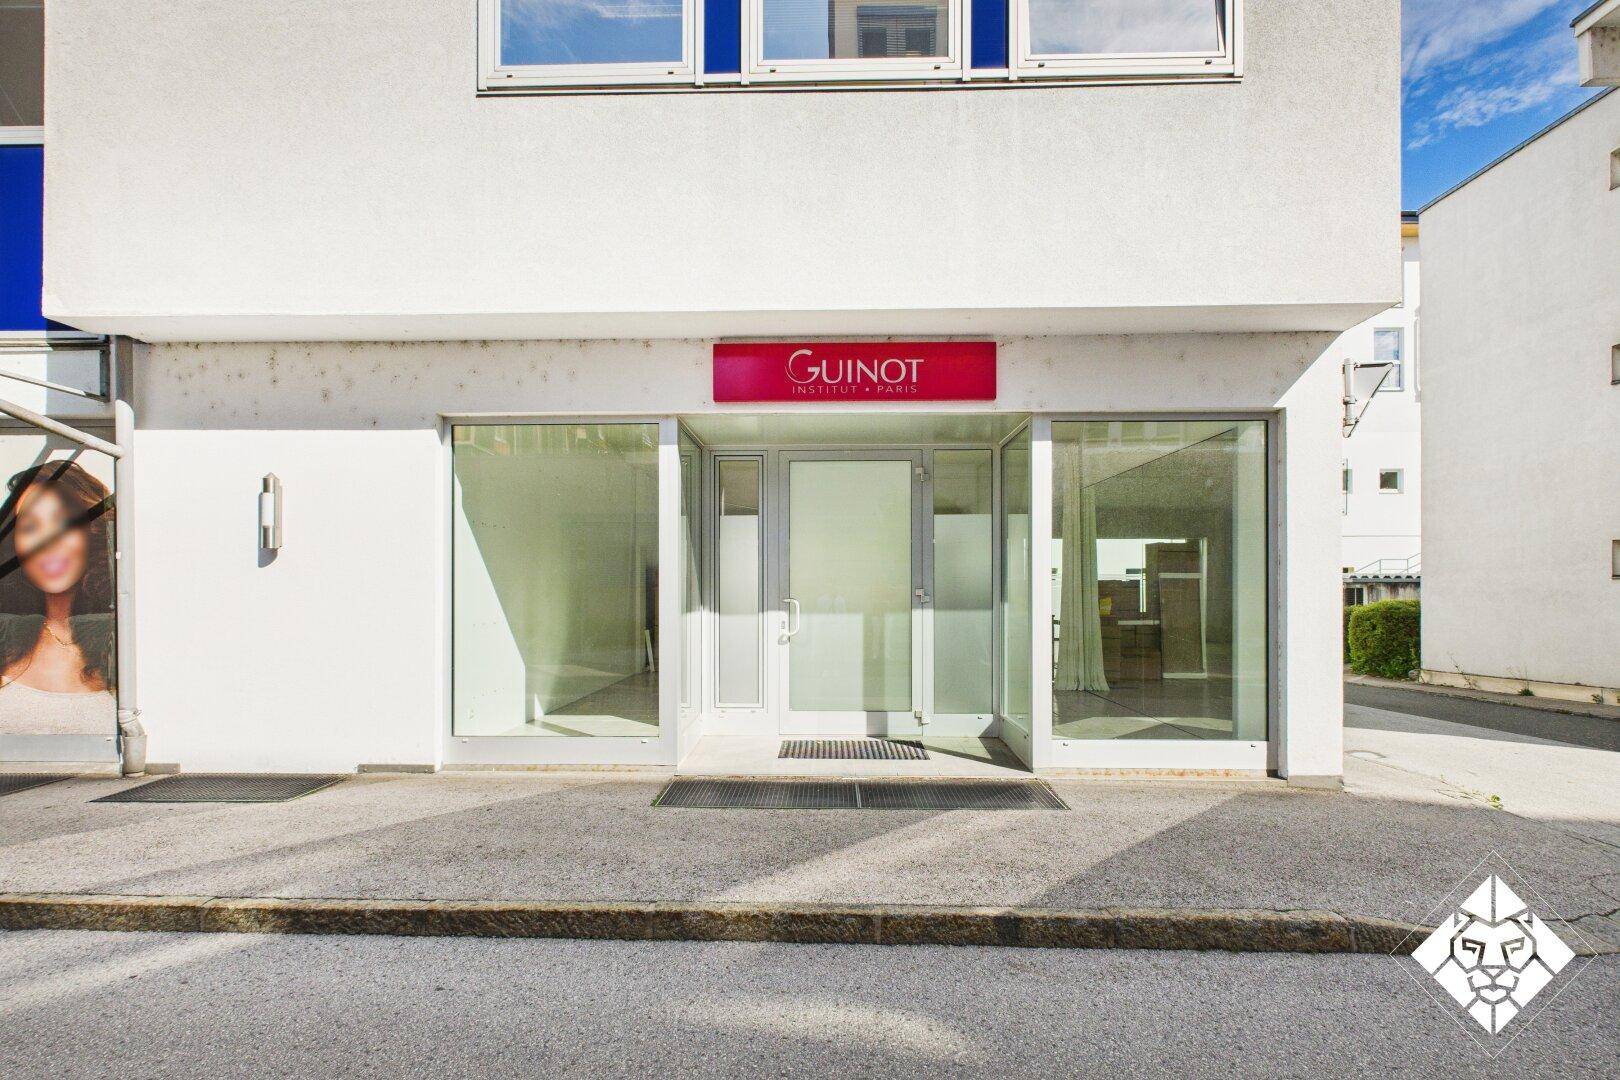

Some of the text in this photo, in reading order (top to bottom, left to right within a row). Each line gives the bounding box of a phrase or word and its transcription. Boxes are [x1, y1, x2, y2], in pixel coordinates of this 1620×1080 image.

[785, 349, 924, 384] GUINOT
[792, 385, 917, 394] INSTITUT PARIS
